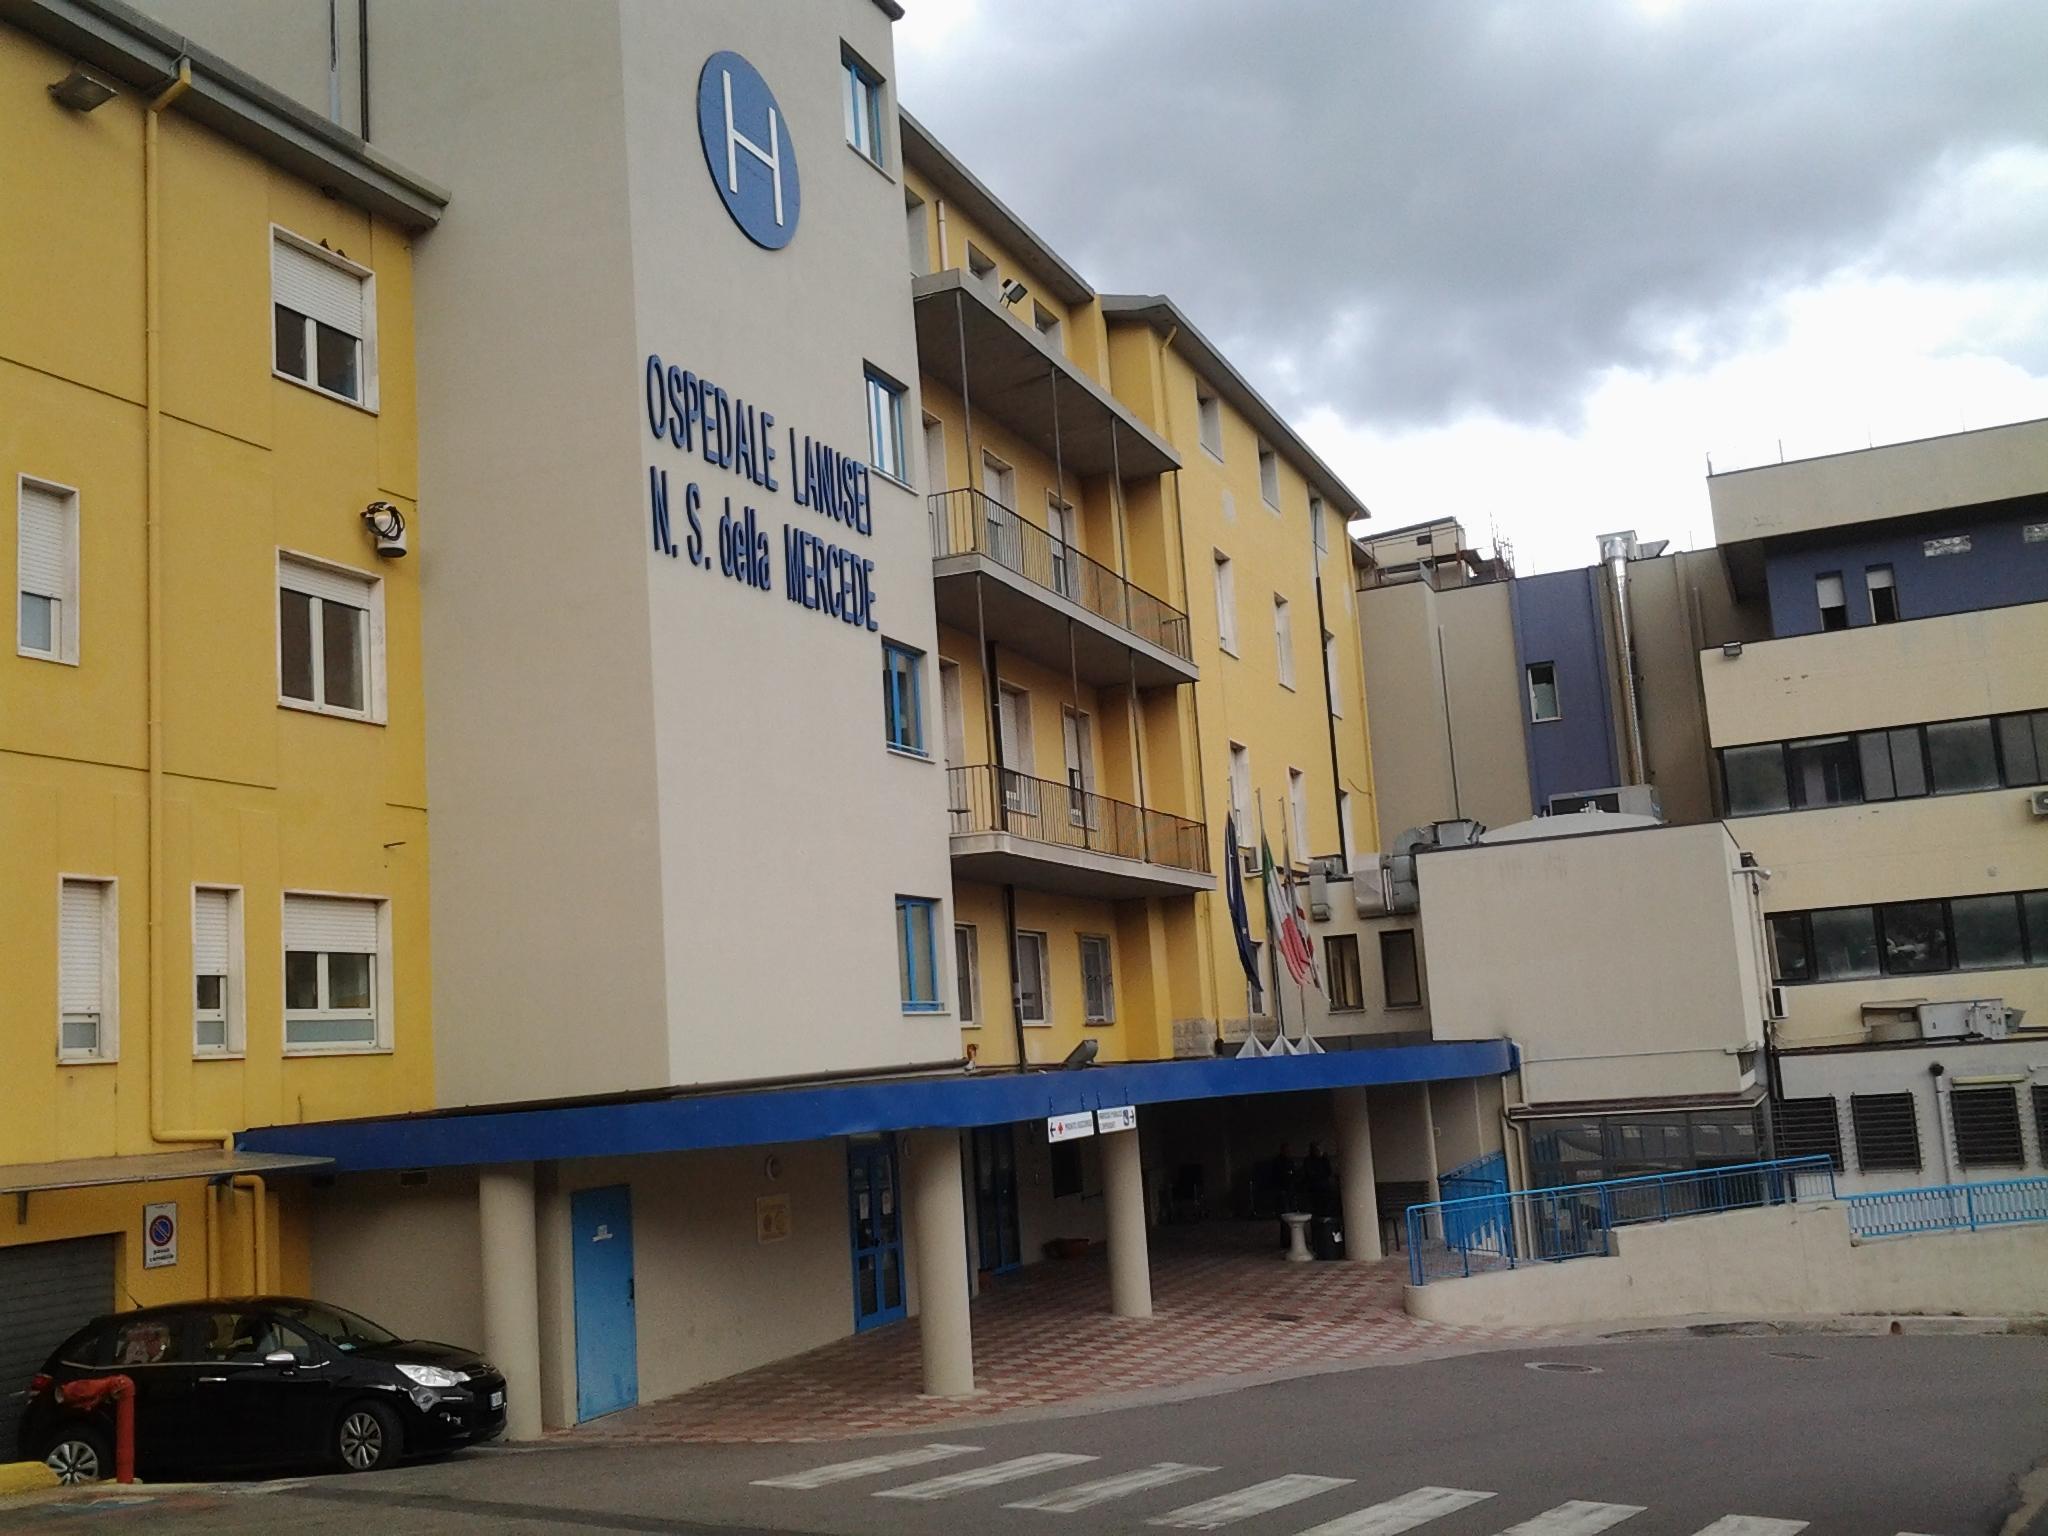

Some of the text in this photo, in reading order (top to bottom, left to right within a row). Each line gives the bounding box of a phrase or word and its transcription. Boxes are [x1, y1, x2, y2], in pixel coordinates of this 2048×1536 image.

[723, 70, 783, 226] H
[646, 353, 872, 537] OSPEDALE LANUSEI
[649, 465, 878, 632] N. S. della MERCEDE
